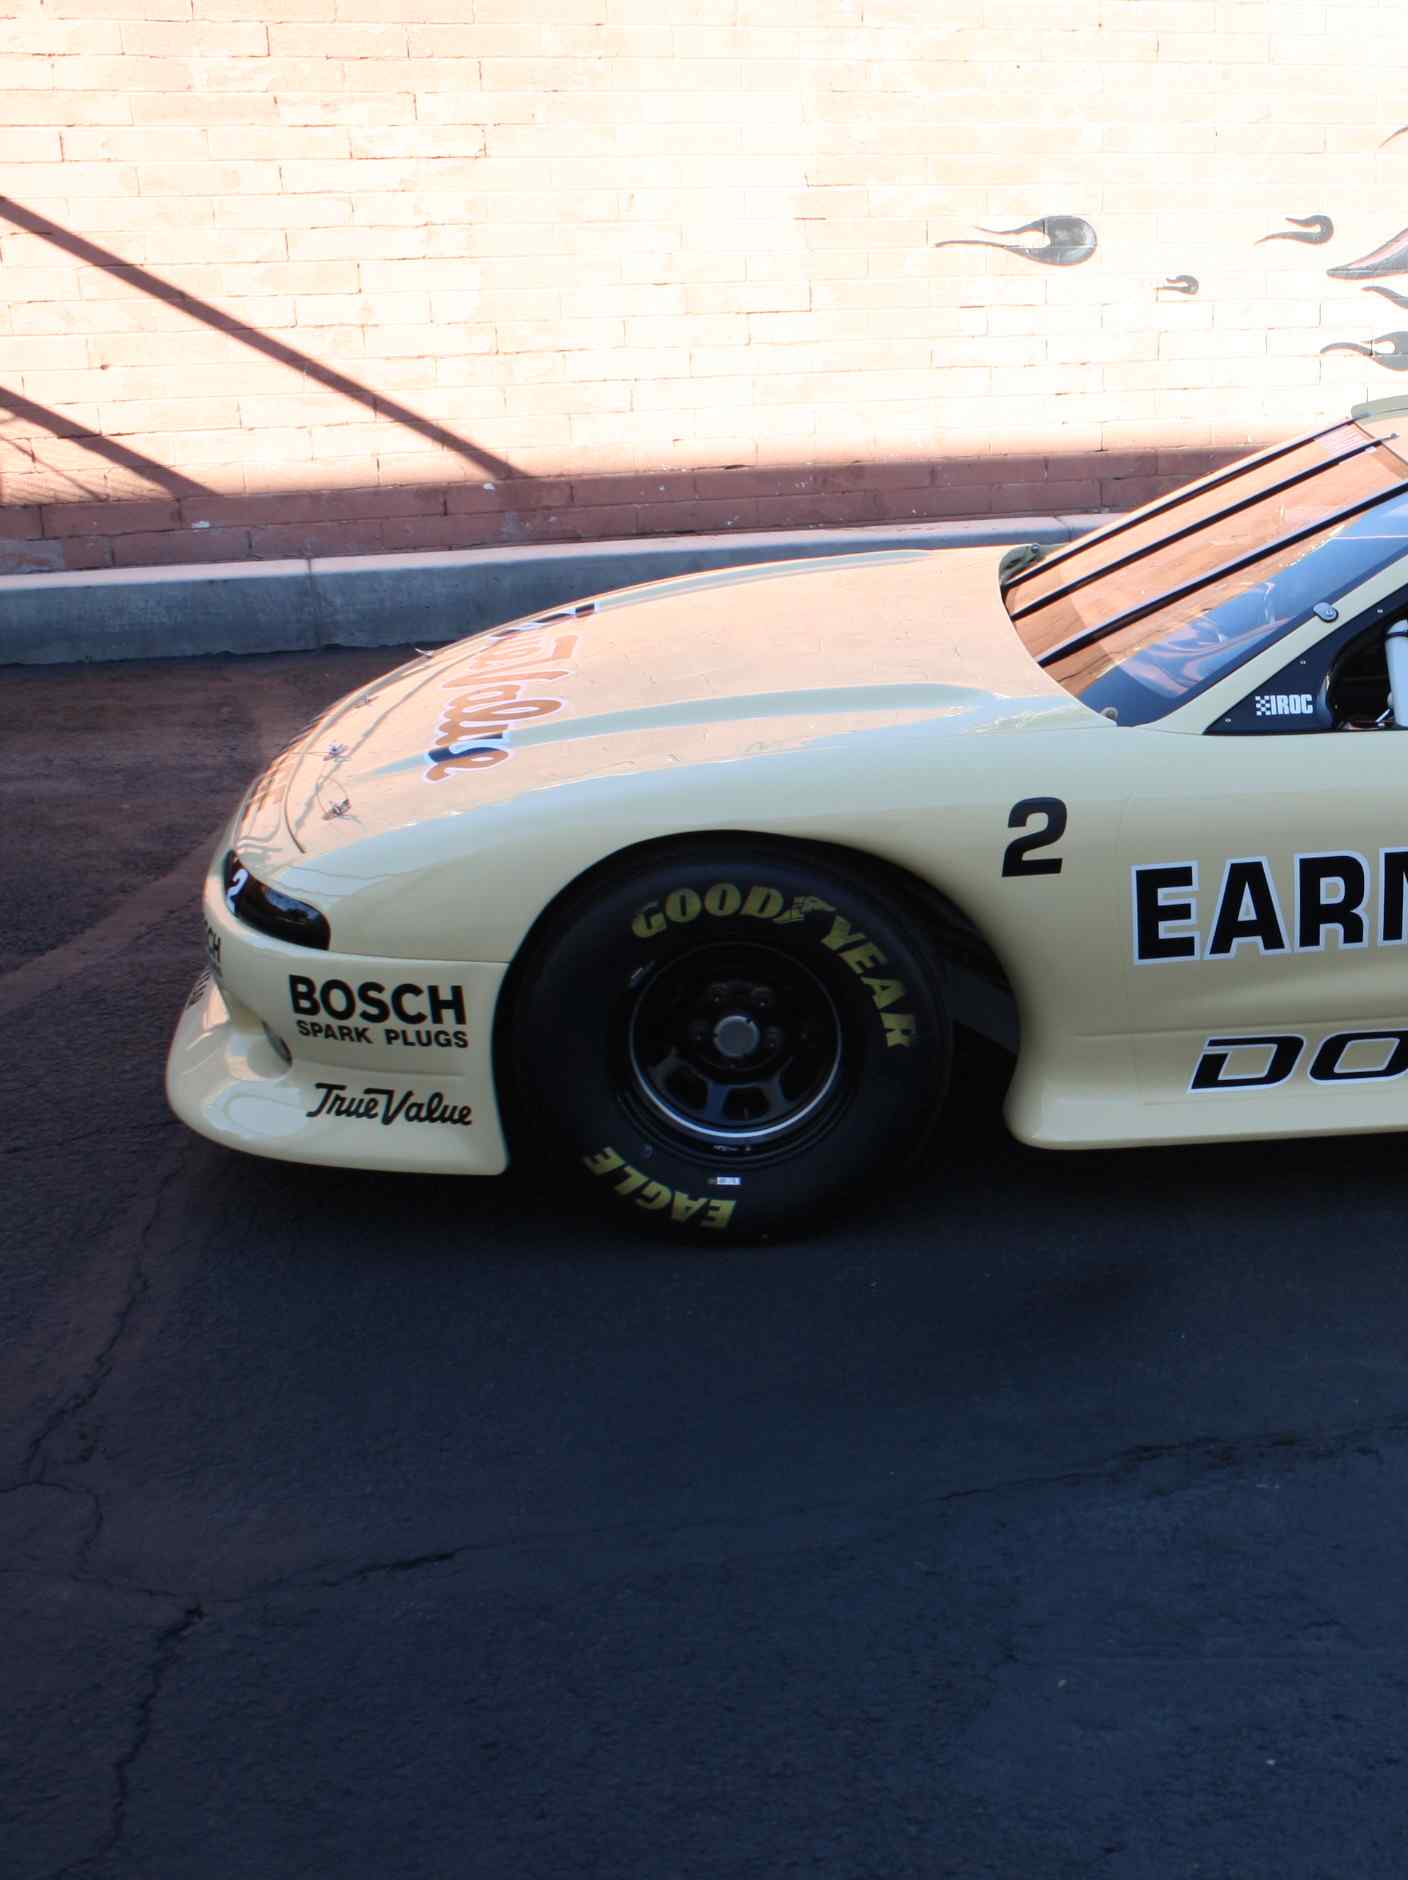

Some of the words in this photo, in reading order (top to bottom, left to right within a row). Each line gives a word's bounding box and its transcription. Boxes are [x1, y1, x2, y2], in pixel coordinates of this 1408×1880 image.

[1270, 694, 1313, 715] IROC
[1001, 796, 1067, 877] 2
[288, 974, 467, 1025] BOSCH
[296, 1019, 374, 1044] SPARK
[384, 1028, 469, 1049] PLUGS
[582, 1146, 737, 1229] EAGLE
